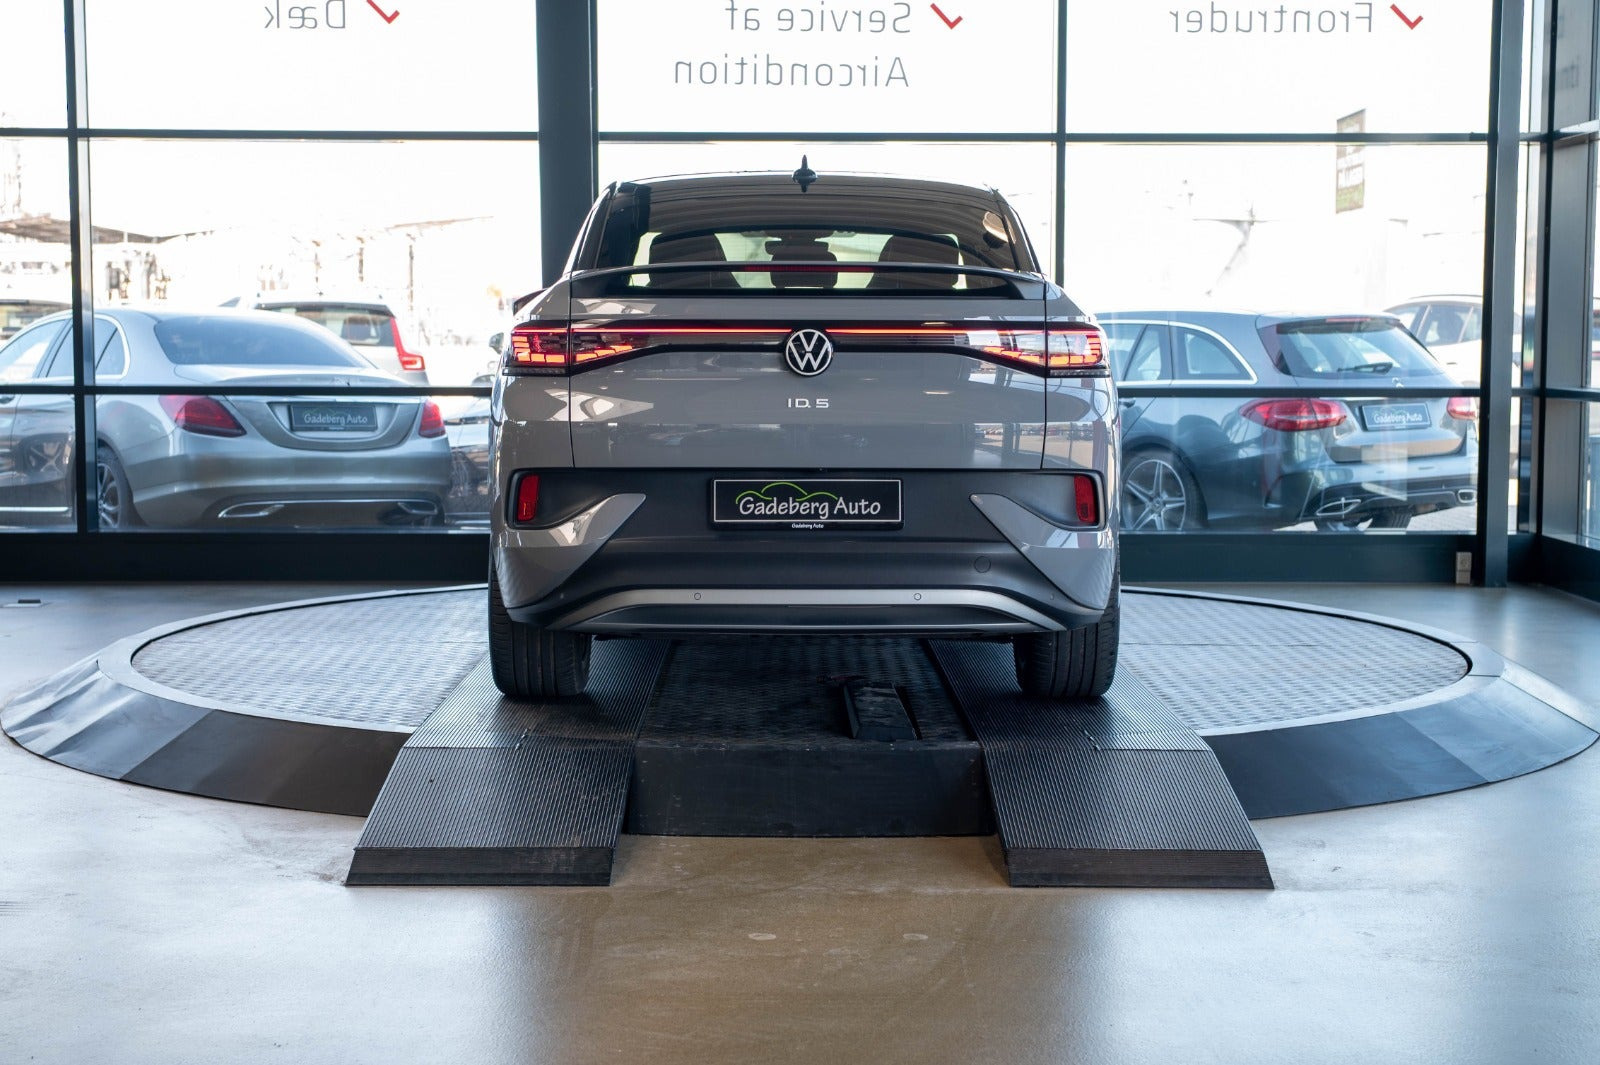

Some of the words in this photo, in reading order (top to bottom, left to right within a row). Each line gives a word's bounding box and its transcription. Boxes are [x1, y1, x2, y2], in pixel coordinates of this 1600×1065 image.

[303, 413, 346, 427] Gadeberg
[346, 413, 368, 424] Auto
[1373, 413, 1407, 425] Gadeberg
[1406, 411, 1423, 421] Auto
[739, 496, 829, 520] Gadeberg
[833, 496, 882, 515] Auto
